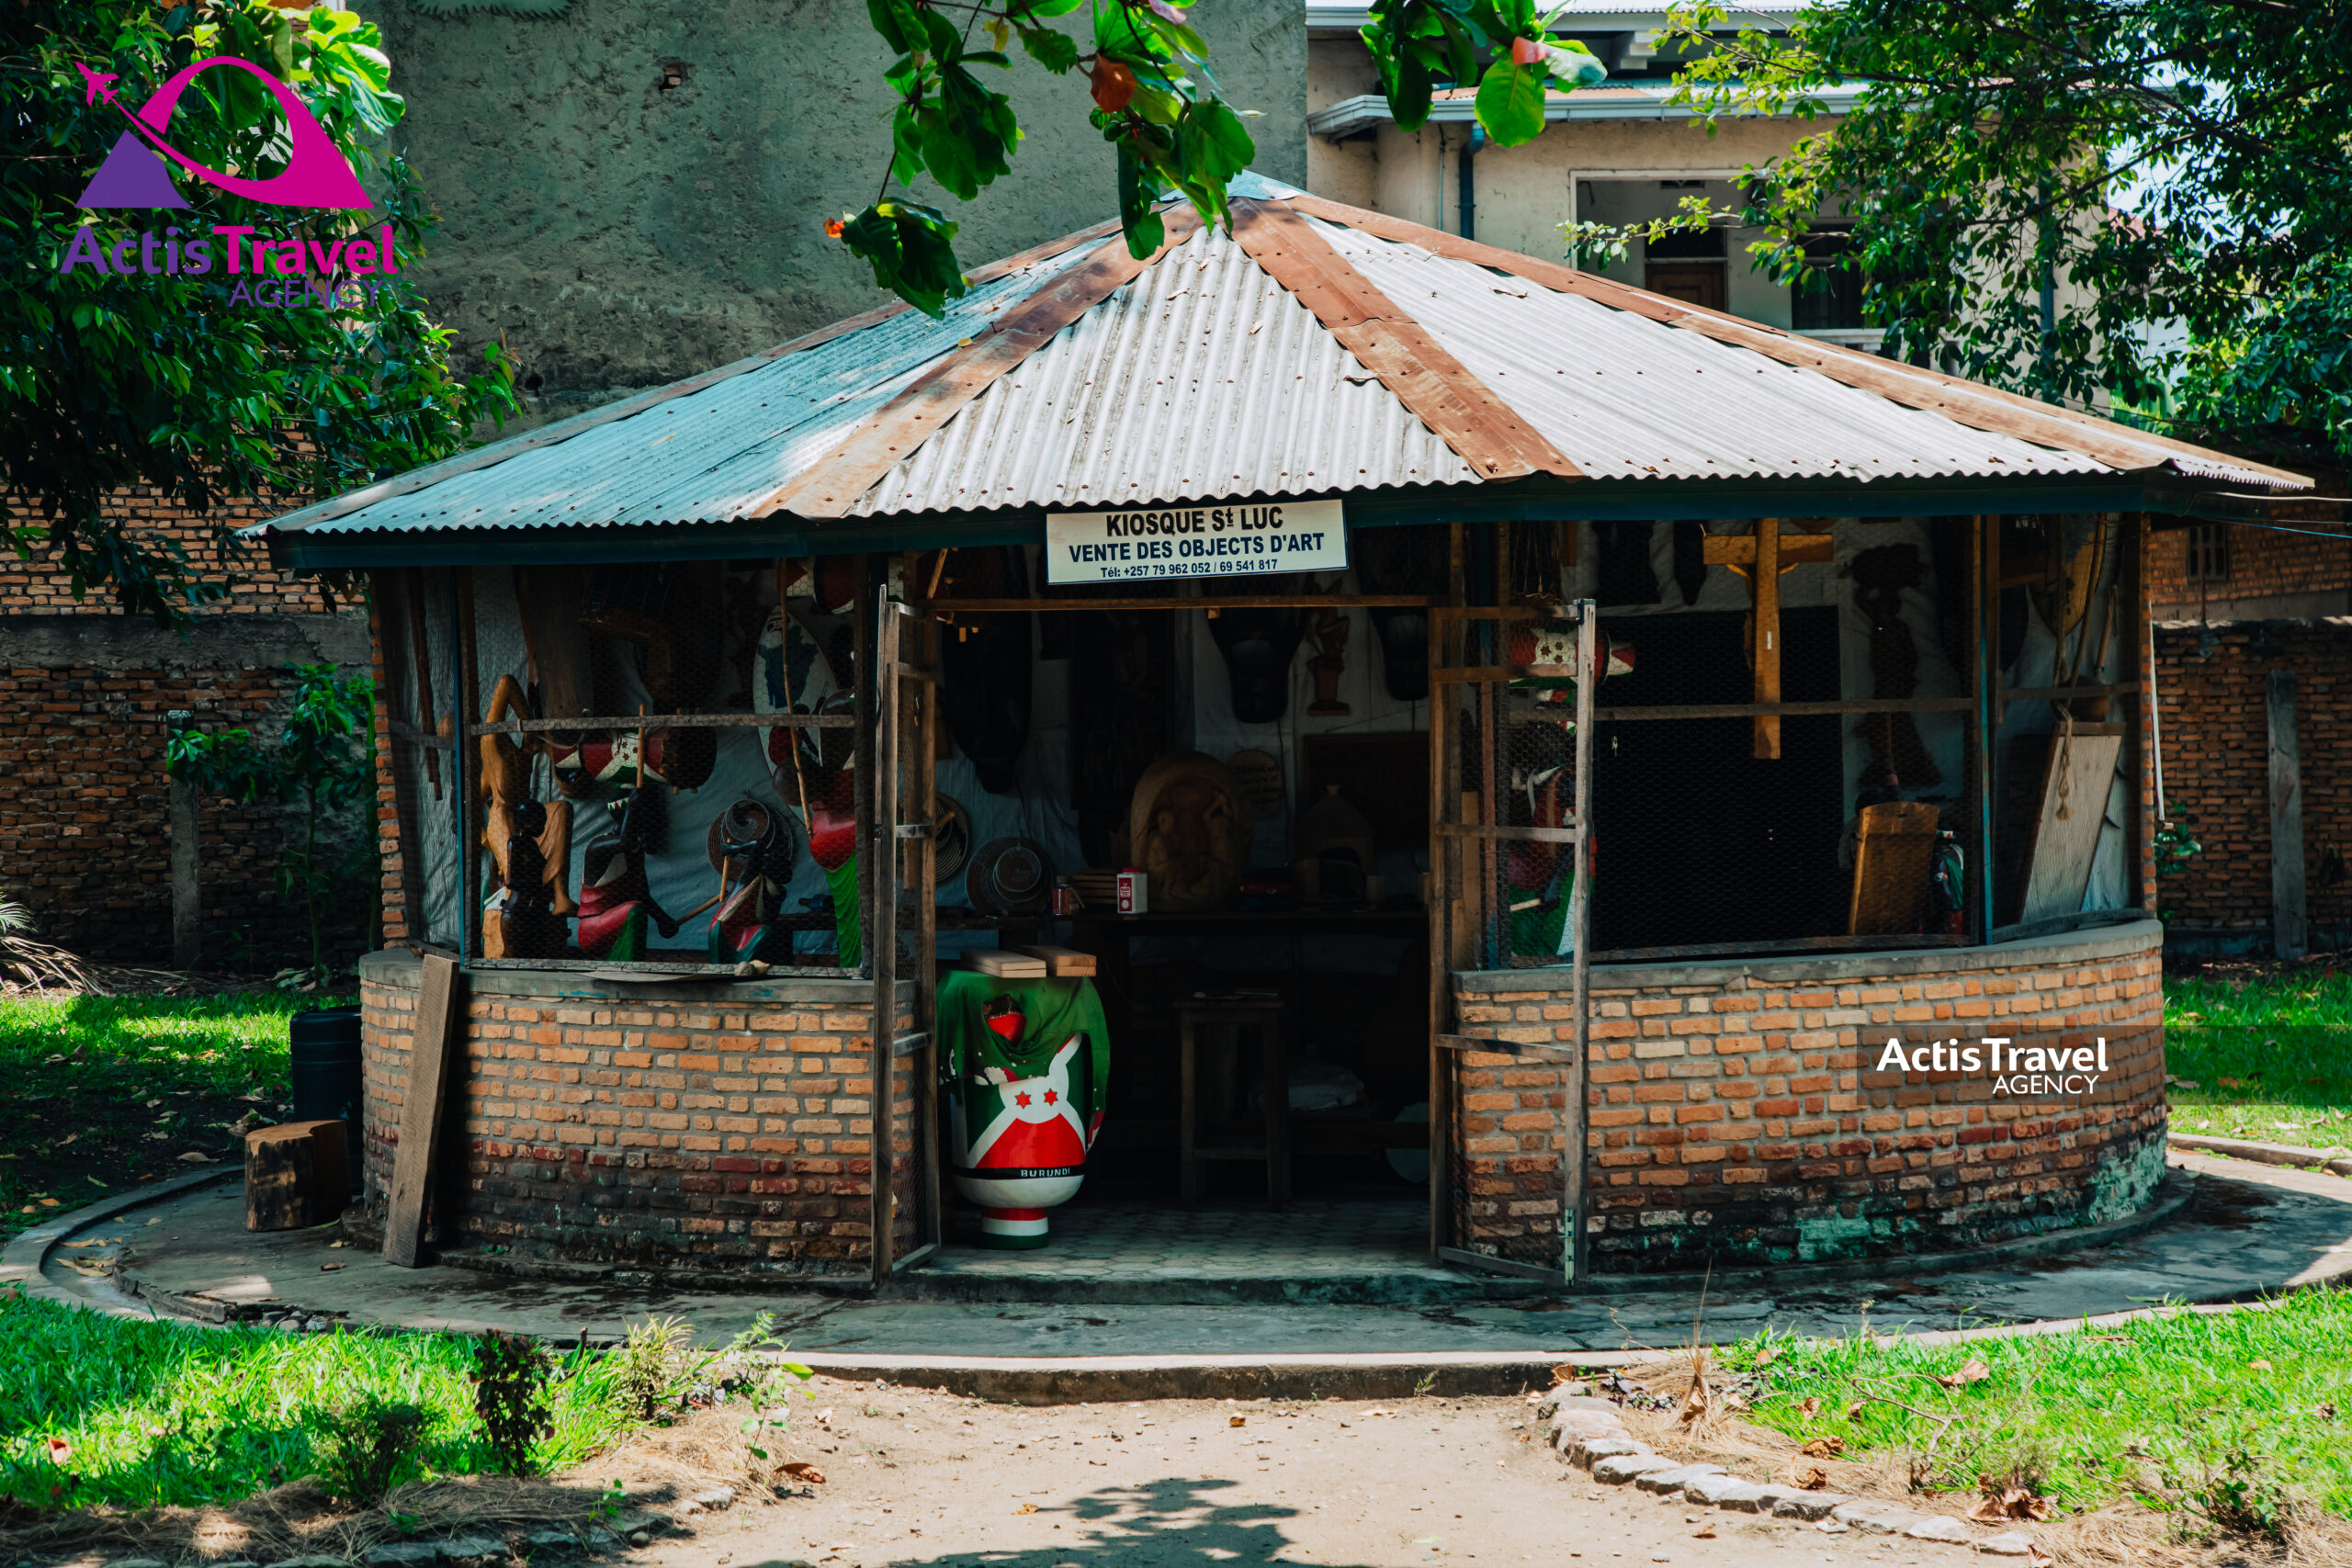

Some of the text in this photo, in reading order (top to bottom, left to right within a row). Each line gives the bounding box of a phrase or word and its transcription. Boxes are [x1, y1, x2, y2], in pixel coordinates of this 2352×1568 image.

[1105, 505, 1284, 537] KIOSQUE St LUC
[1069, 533, 1325, 563] VENTE DES OBJECTS D'ART
[1100, 558, 1278, 579] Tél: +257 79 962 052 / 69 541 817
[1020, 1167, 1070, 1178] BURUNDI
